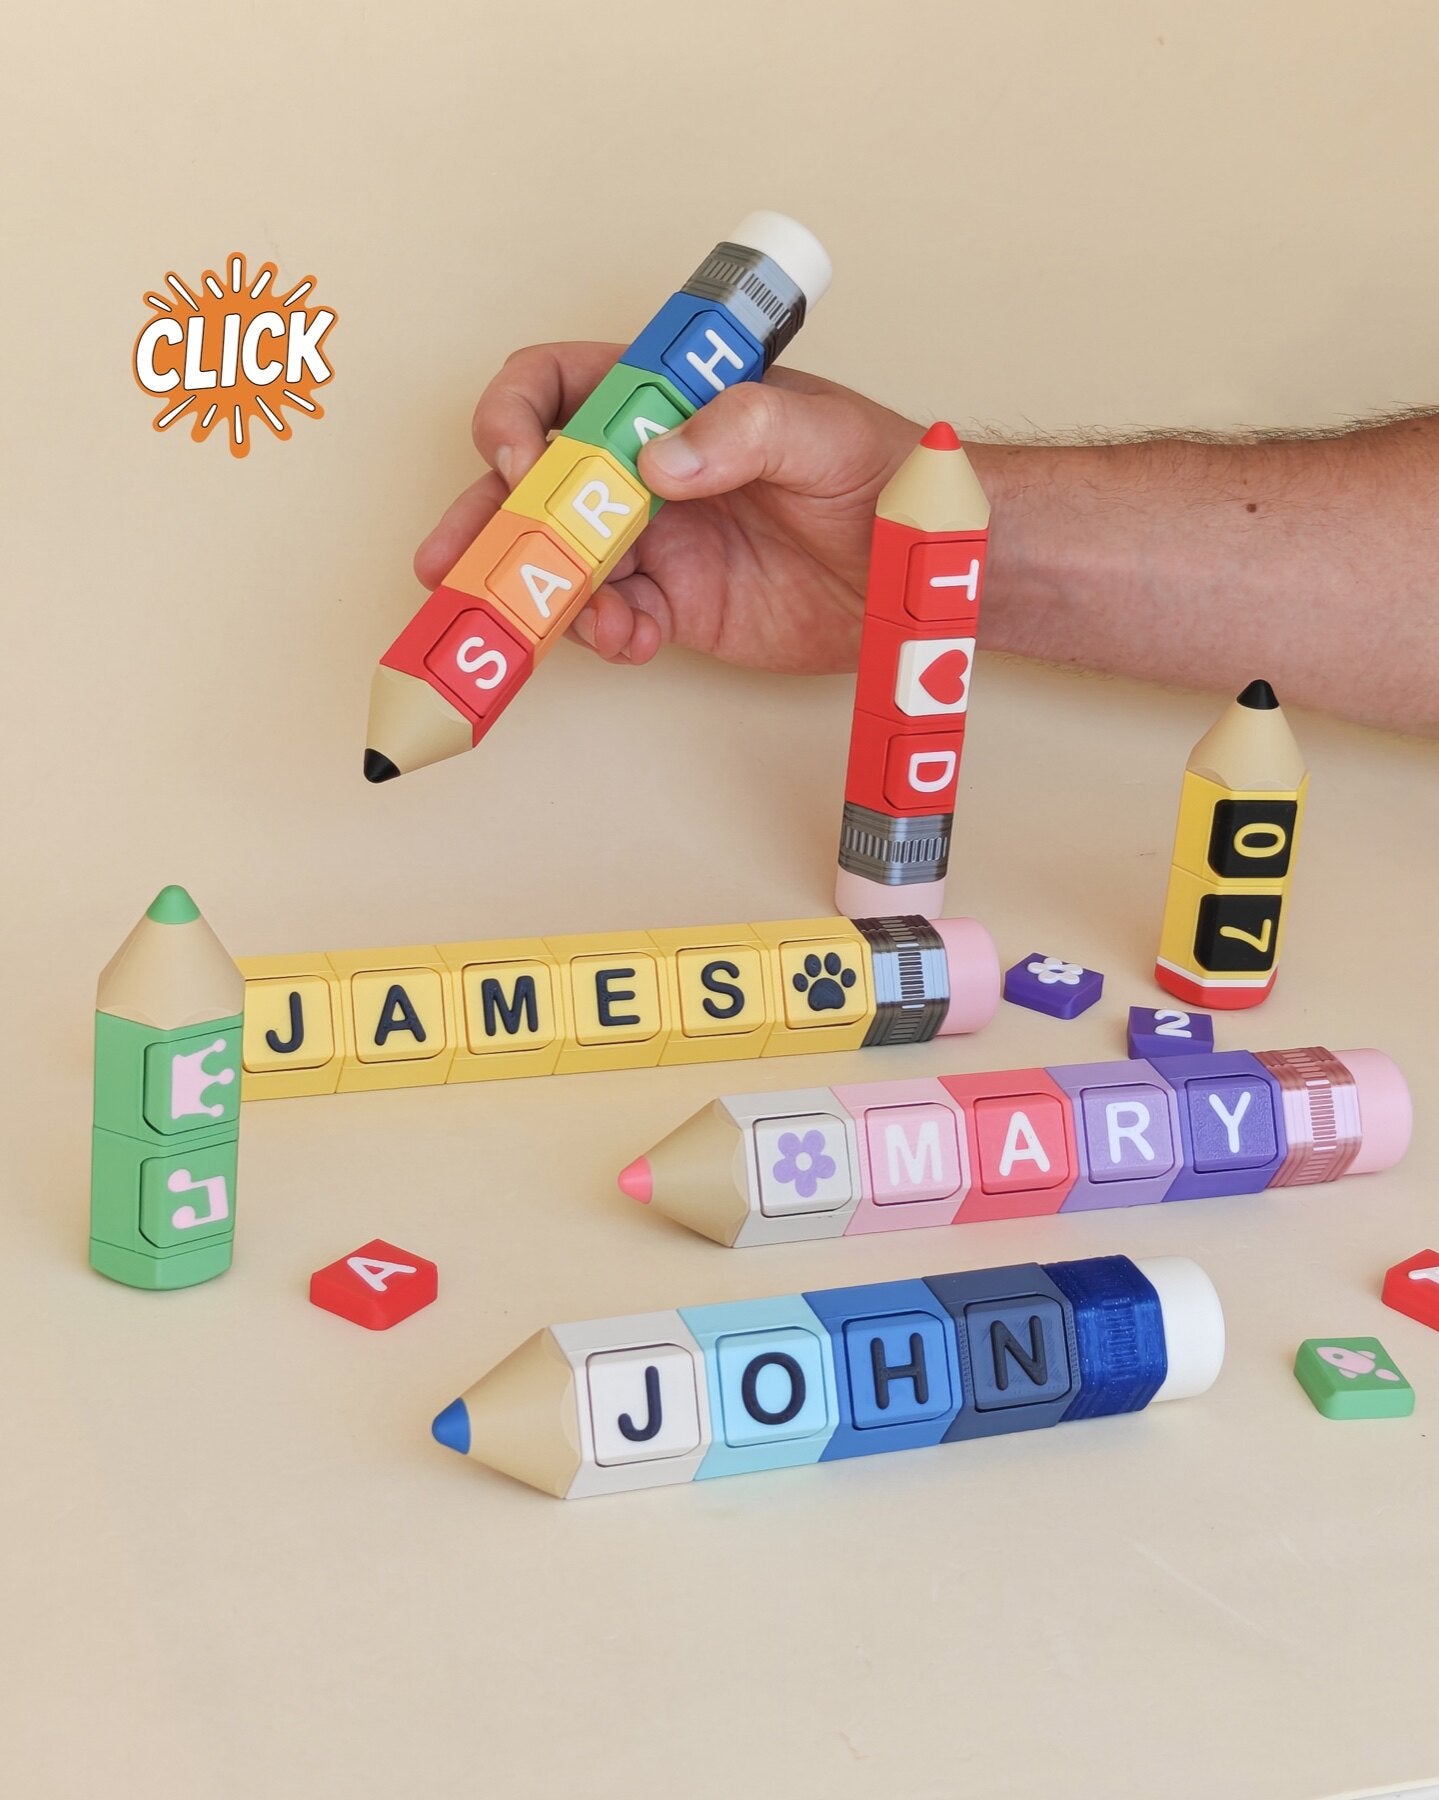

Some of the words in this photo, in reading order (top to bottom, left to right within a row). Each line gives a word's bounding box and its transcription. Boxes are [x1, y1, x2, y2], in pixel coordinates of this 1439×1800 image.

[265, 960, 745, 1054] JAMES
[1154, 1009, 1192, 1038] 2
[884, 1090, 1252, 1186] MARY
[346, 1256, 417, 1292] A
[617, 1315, 1048, 1442] JOHN
